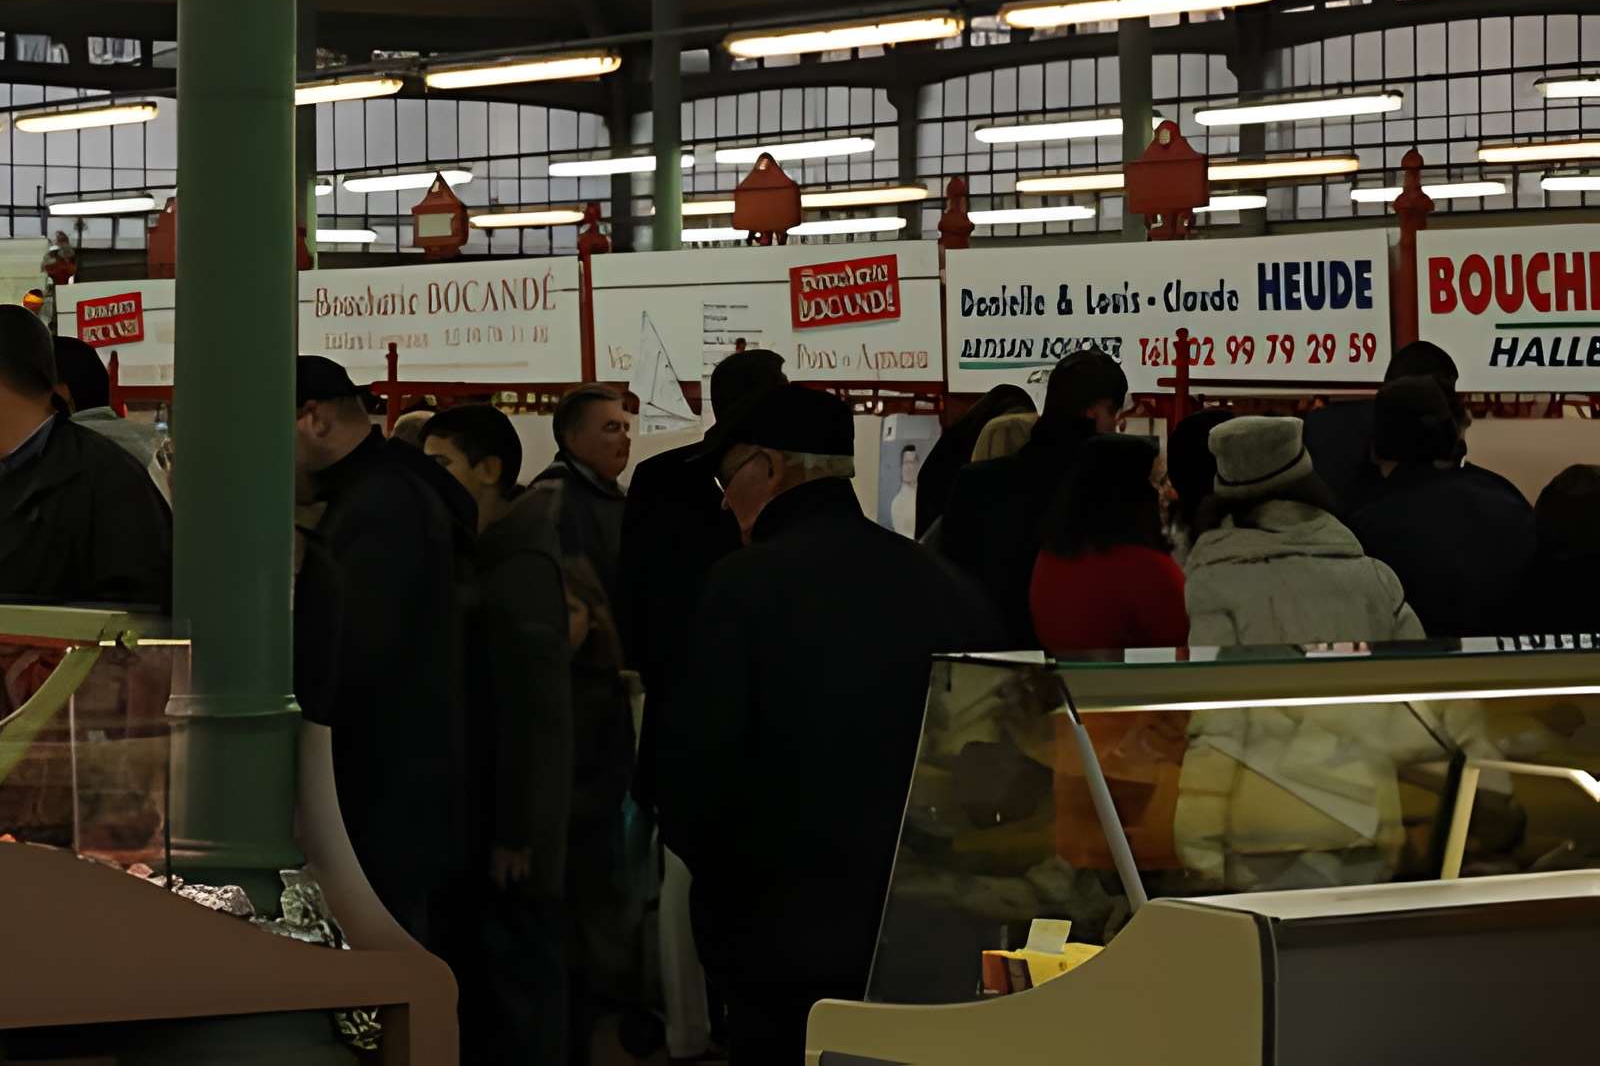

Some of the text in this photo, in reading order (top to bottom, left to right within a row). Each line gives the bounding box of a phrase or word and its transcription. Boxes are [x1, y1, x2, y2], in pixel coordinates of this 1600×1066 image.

[1257, 259, 1374, 311] HEUDE
[1225, 334, 1256, 365] 99
[1266, 333, 1296, 364] 79
[1306, 333, 1337, 364] 29
[1348, 331, 1377, 363] 59
